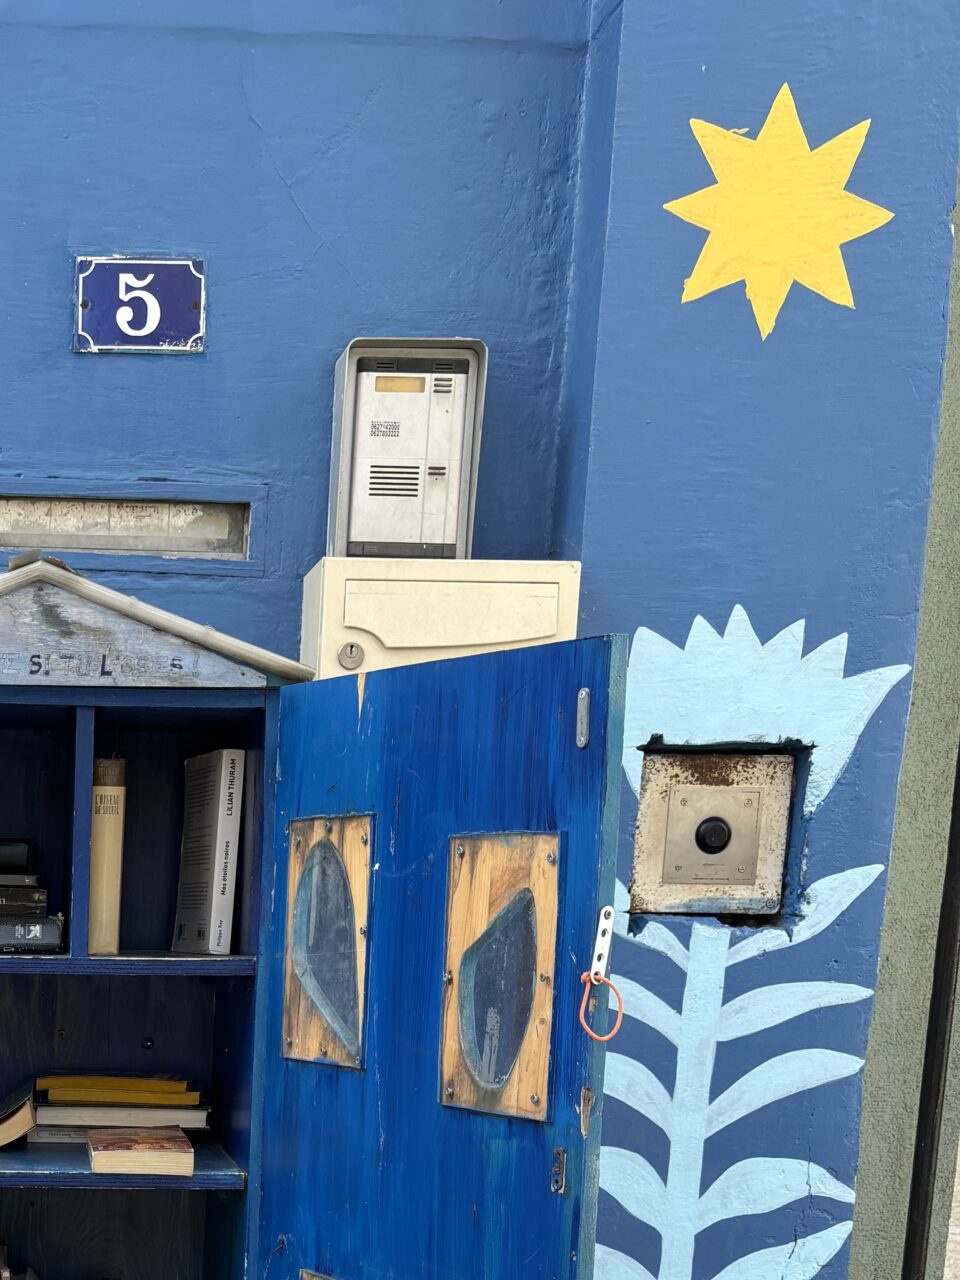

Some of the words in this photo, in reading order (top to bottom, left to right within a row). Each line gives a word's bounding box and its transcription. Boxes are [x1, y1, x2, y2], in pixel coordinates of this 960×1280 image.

[116, 273, 161, 337] 5
[228, 758, 237, 790] THURAM
[226, 792, 234, 816] LILIAN
